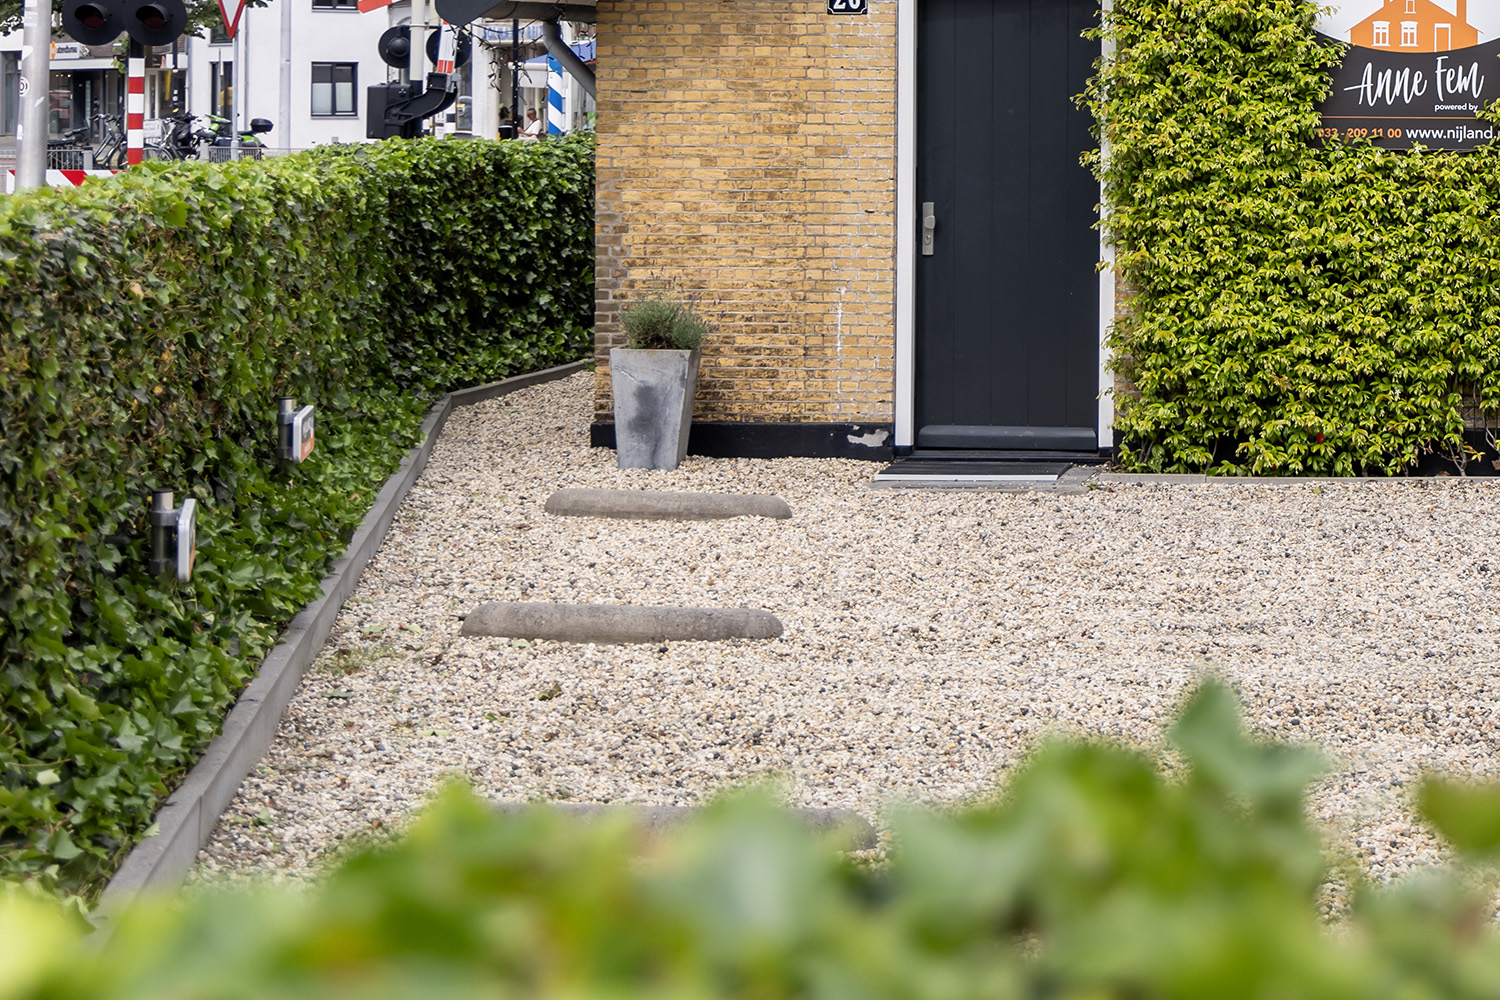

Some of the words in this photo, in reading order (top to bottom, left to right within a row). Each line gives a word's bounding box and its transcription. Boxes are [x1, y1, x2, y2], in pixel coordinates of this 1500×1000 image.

[1343, 62, 1428, 107] Anne
[1435, 55, 1484, 102] Fem
[1434, 103, 1467, 112] powered
[1468, 103, 1479, 113] by
[1347, 127, 1368, 138] 209
[1371, 128, 1384, 138] 11
[1387, 127, 1402, 139] 00
